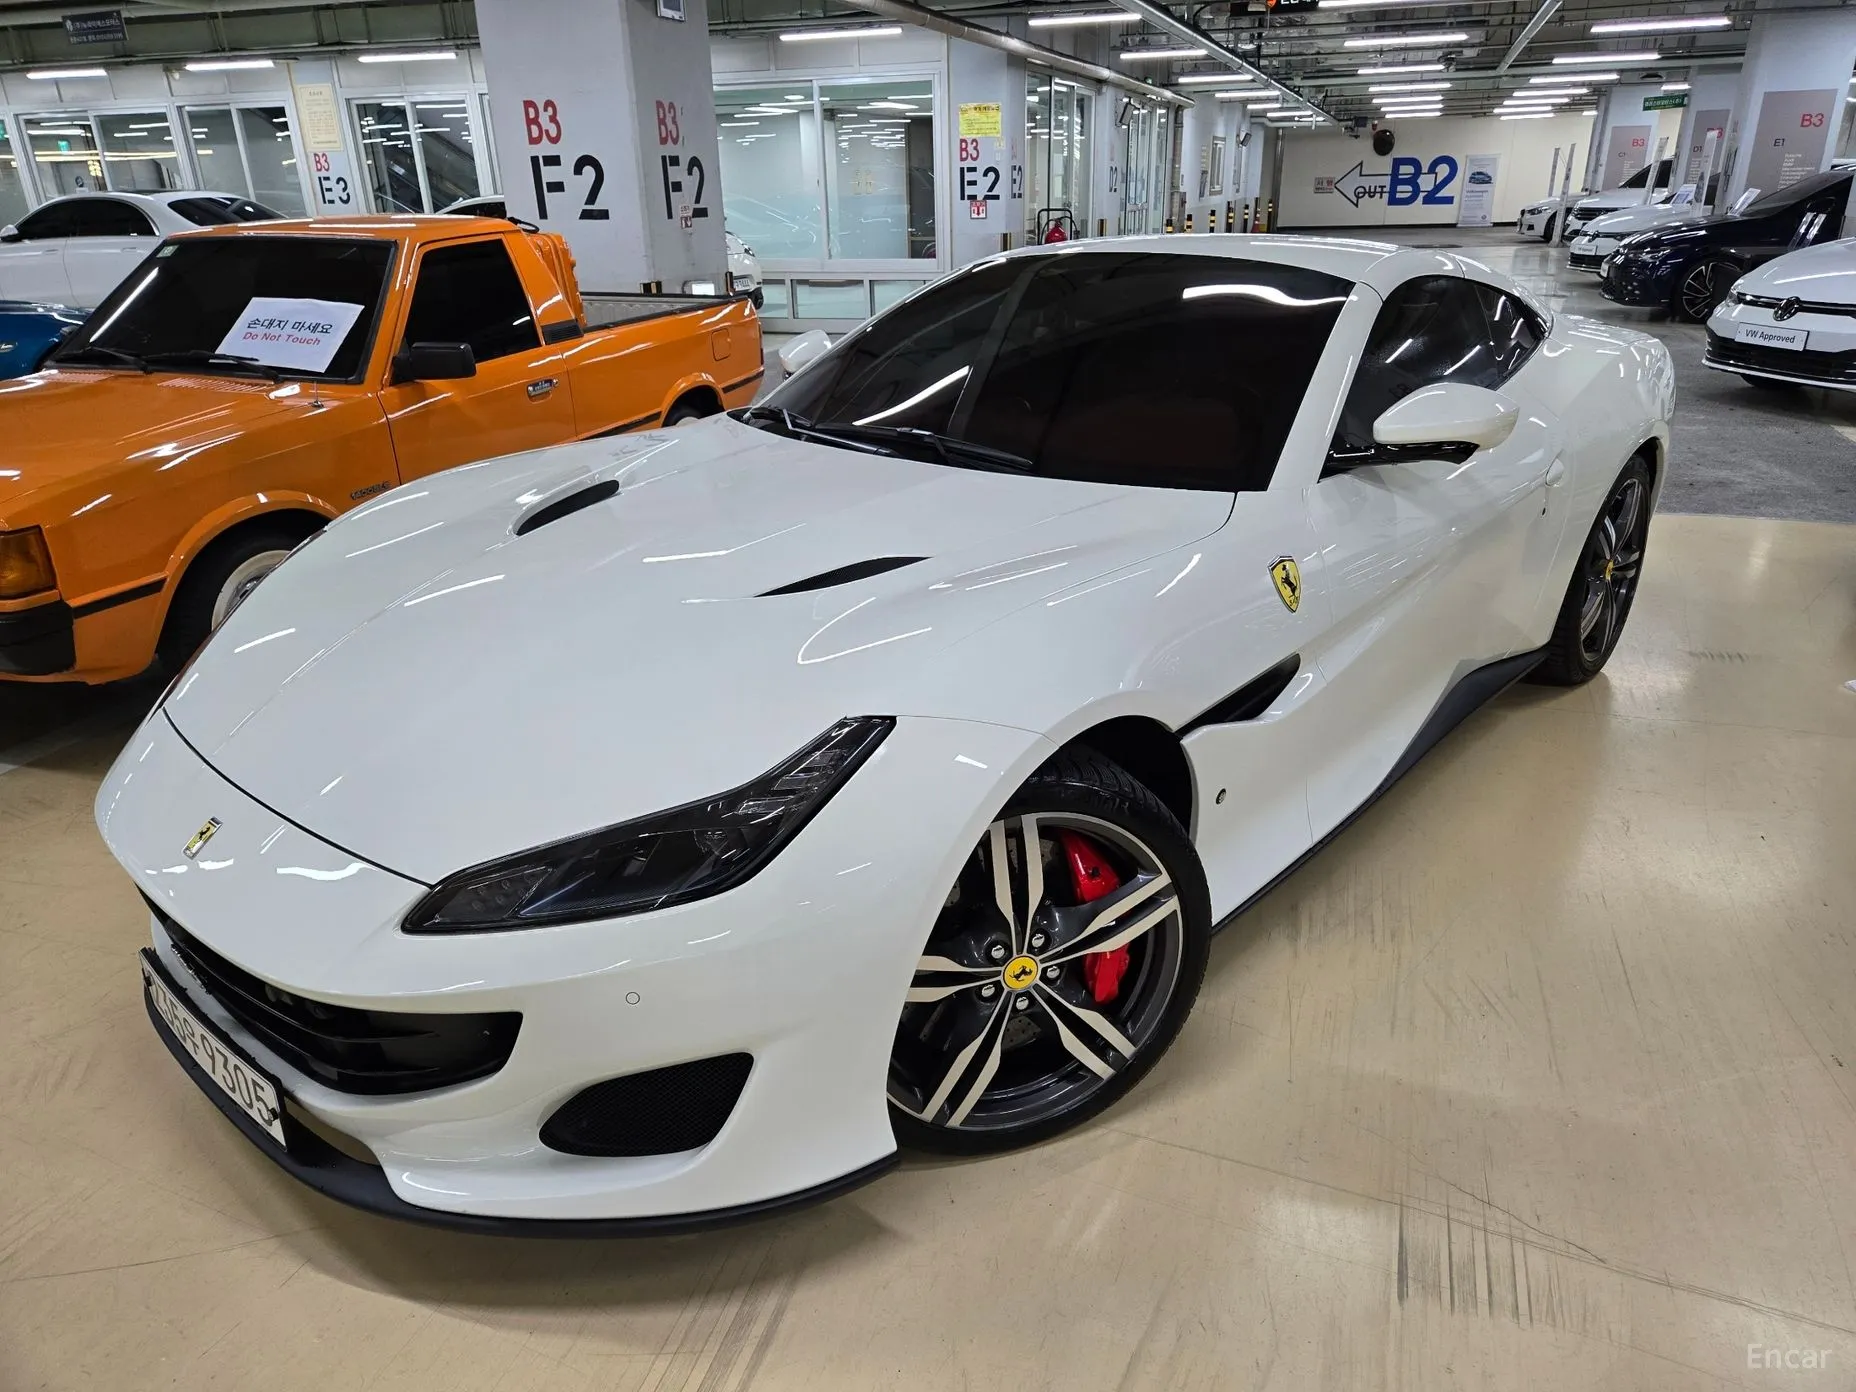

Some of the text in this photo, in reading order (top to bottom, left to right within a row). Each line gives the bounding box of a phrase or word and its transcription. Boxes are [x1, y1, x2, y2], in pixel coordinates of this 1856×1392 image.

[522, 99, 562, 146] B3
[655, 99, 680, 146] B3
[1800, 112, 1825, 128] B3
[959, 138, 980, 161] B3
[1631, 138, 1646, 148] B3
[1773, 138, 1785, 147] E1
[313, 152, 330, 172] B3
[318, 176, 351, 205] E3
[530, 154, 610, 220] F2
[660, 154, 708, 220] F2
[959, 166, 1000, 200] E2
[1010, 165, 1023, 199] E2
[1353, 185, 1387, 199] OUT
[1387, 155, 1458, 206] B2
[242, 331, 321, 346] Do Not Touch
[247, 317, 333, 334] 손대지 마세요
[1745, 328, 1796, 343] VW Approved
[200, 1033, 273, 1127] 9305
